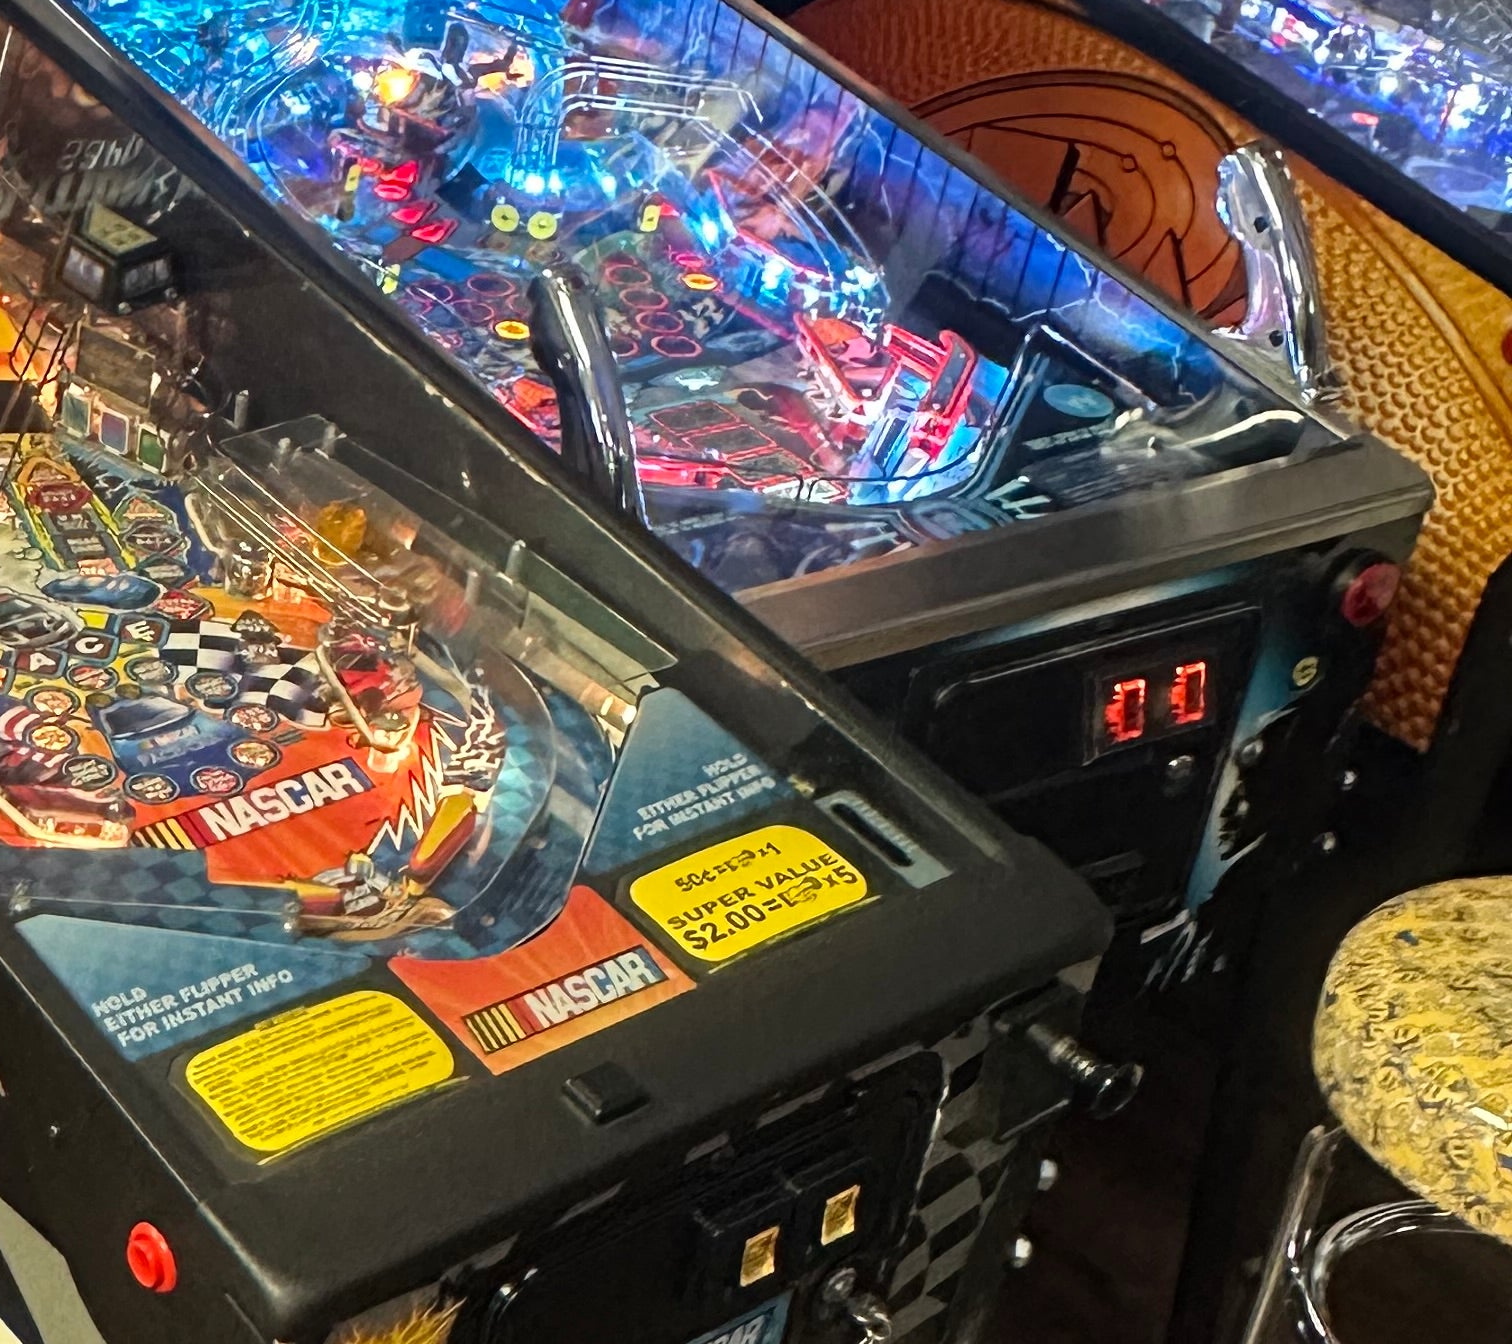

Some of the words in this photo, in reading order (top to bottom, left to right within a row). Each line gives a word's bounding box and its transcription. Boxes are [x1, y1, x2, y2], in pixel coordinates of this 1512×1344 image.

[199, 761, 362, 841] NASCAR
[667, 886, 755, 929] SUPER
[755, 853, 838, 890] VALUE
[104, 994, 180, 1033] EITHER
[179, 963, 259, 1003] FLIPPER
[117, 1021, 160, 1048] FOR
[162, 987, 243, 1031] INSTANT
[247, 969, 294, 997] INFO
[525, 951, 658, 1029] NASCAR
